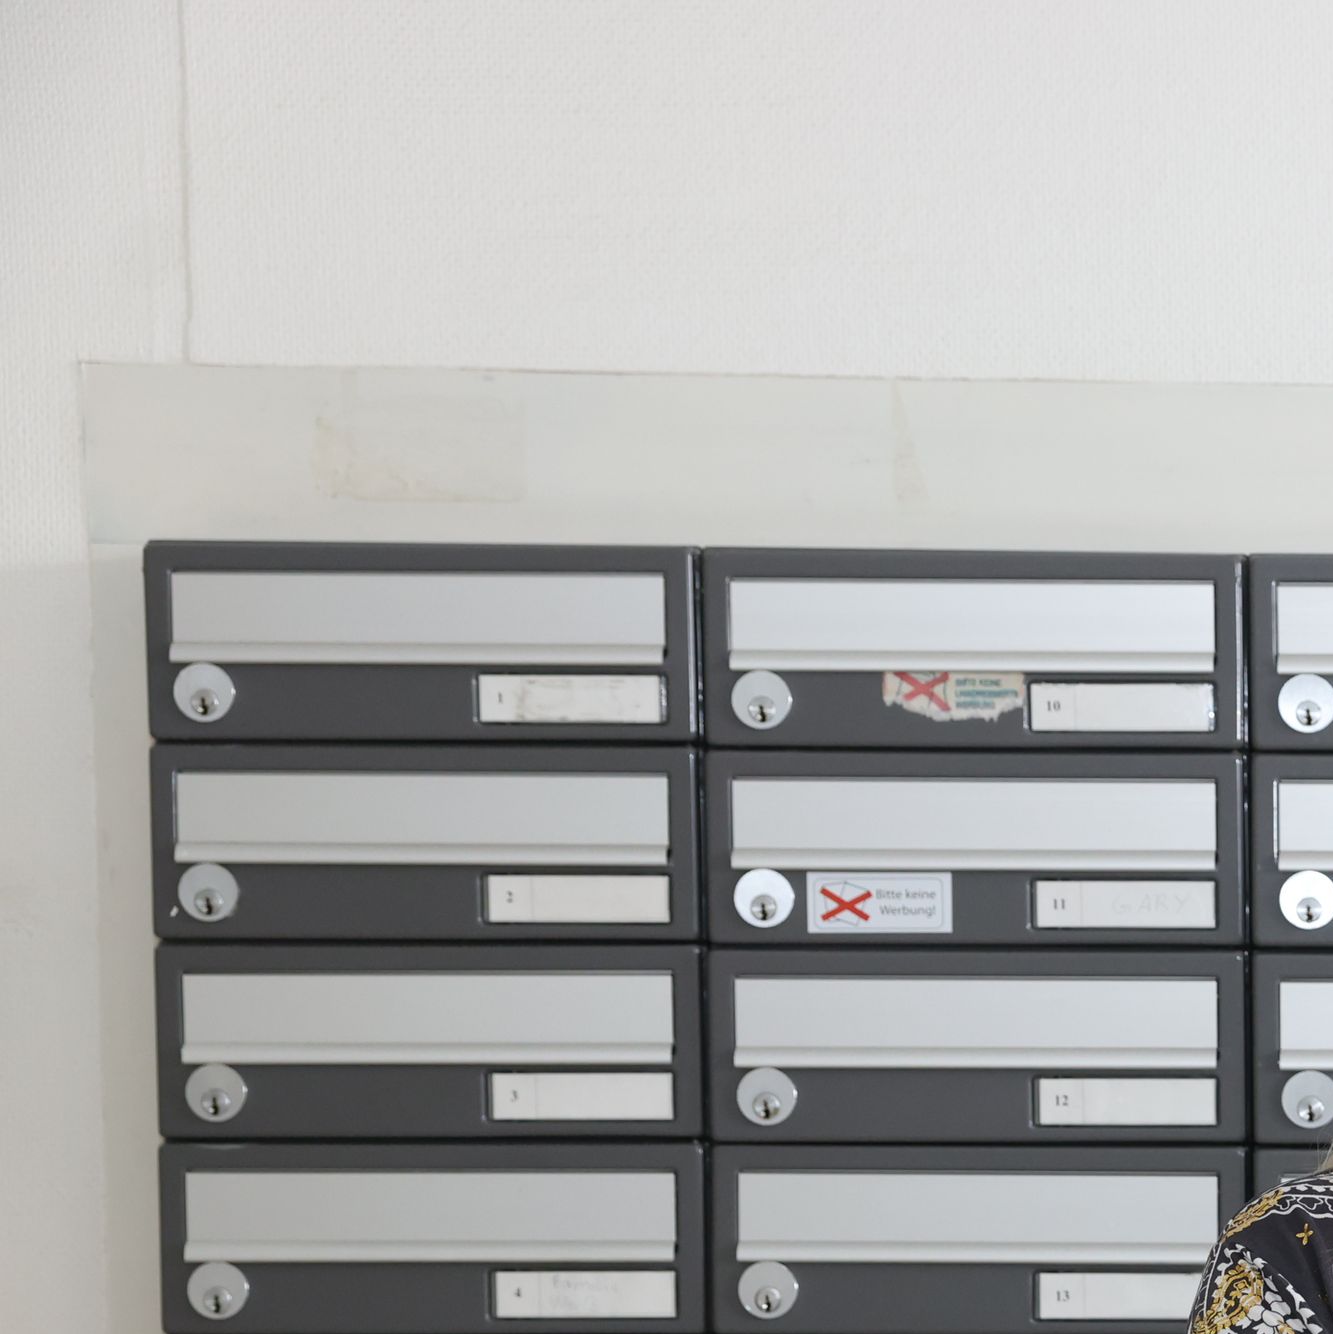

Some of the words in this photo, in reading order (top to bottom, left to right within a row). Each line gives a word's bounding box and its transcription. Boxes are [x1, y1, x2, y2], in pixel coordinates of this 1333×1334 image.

[497, 691, 504, 704] 1
[1046, 700, 1062, 712] 10
[506, 890, 514, 904] 2
[875, 888, 902, 900] Bitte
[905, 888, 937, 900] keine
[1053, 898, 1066, 911] 11
[880, 905, 937, 919] Werbung!
[511, 1089, 519, 1101] 3
[1055, 1094, 1069, 1107] 12
[514, 1287, 522, 1298] 4
[1056, 1289, 1070, 1302] 13
